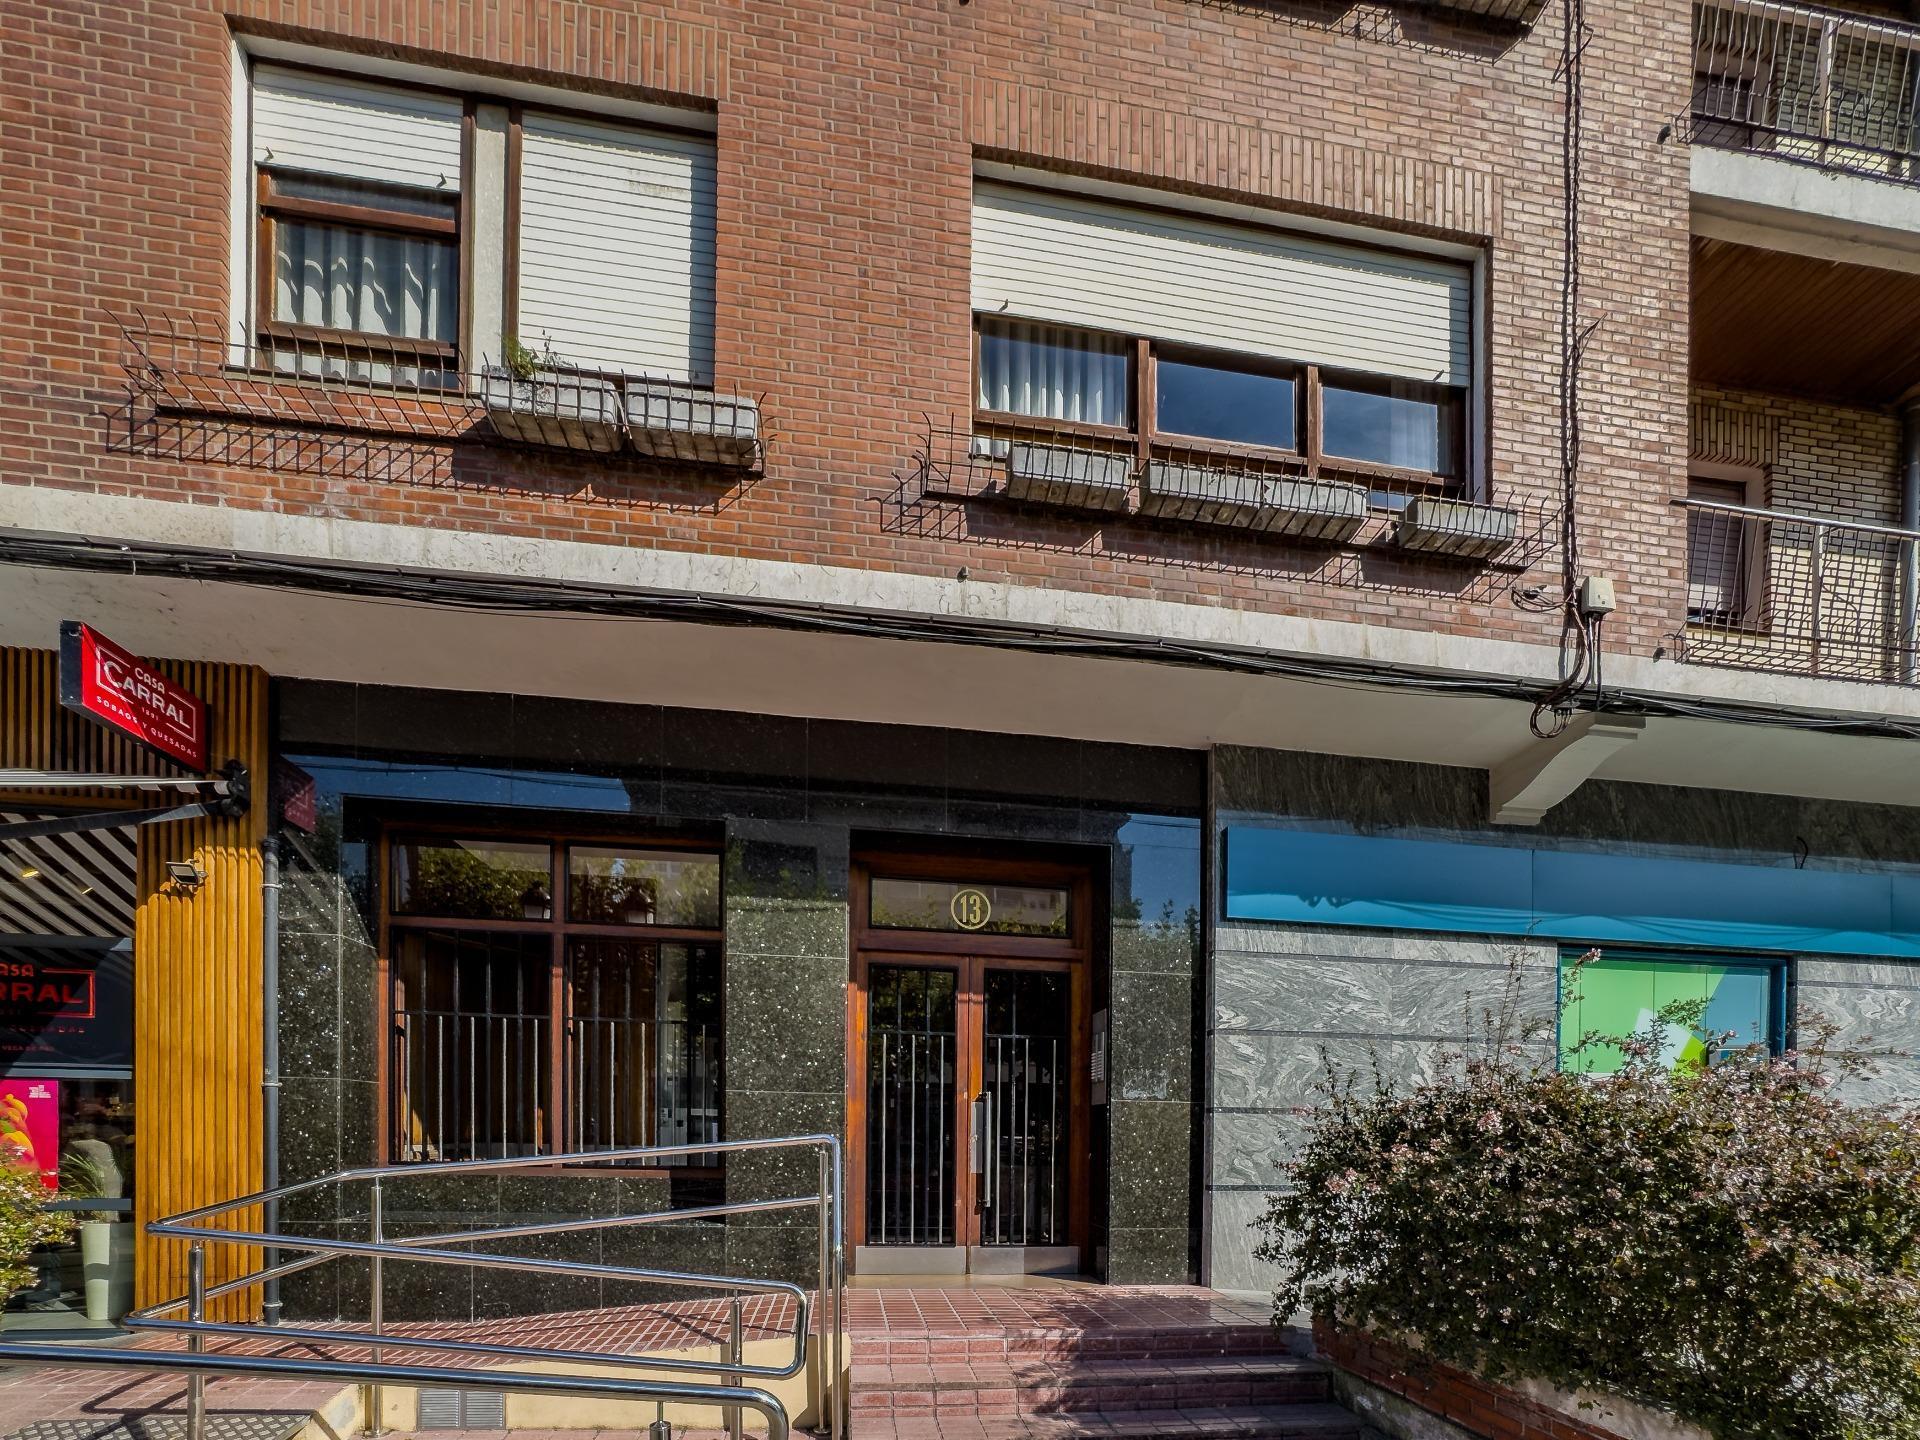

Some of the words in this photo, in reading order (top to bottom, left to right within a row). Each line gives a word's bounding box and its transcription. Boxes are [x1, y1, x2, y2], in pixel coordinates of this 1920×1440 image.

[103, 660, 191, 729] CARRAL
[134, 667, 166, 695] CASA
[96, 695, 138, 724] SOBAOS
[142, 721, 148, 729] Y
[150, 727, 197, 758] QUESADAS
[960, 894, 981, 924] 13
